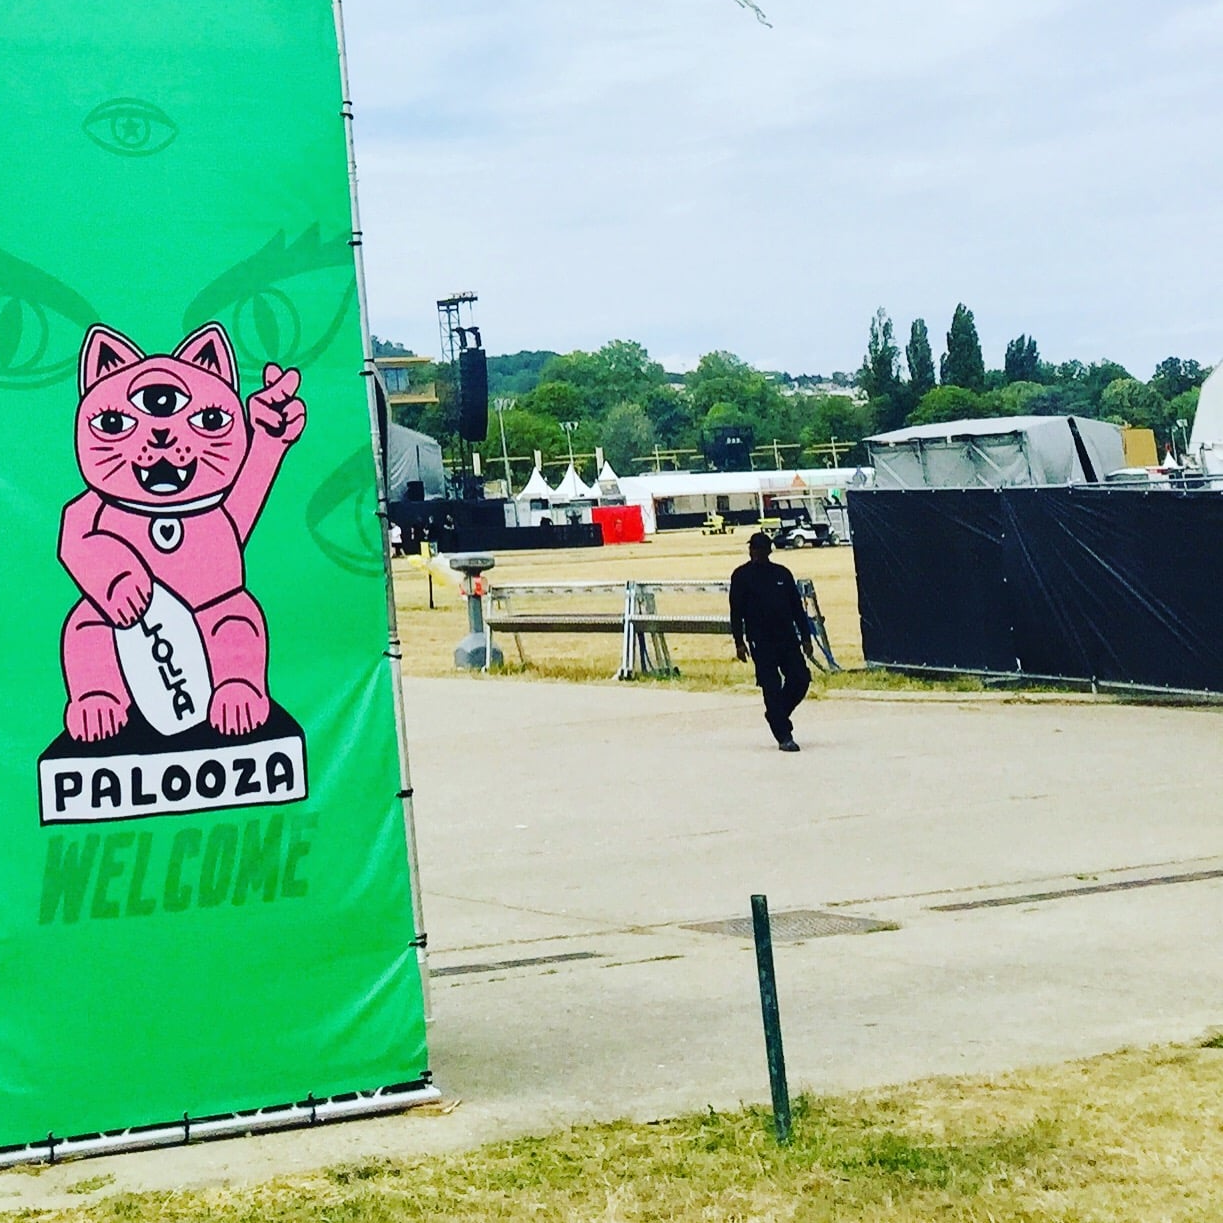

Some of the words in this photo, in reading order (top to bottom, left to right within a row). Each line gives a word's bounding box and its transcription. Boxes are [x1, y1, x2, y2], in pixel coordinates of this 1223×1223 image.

[137, 614, 195, 721] LOLLA
[54, 751, 295, 812] PALOOZA
[38, 811, 321, 926] WELCOME
